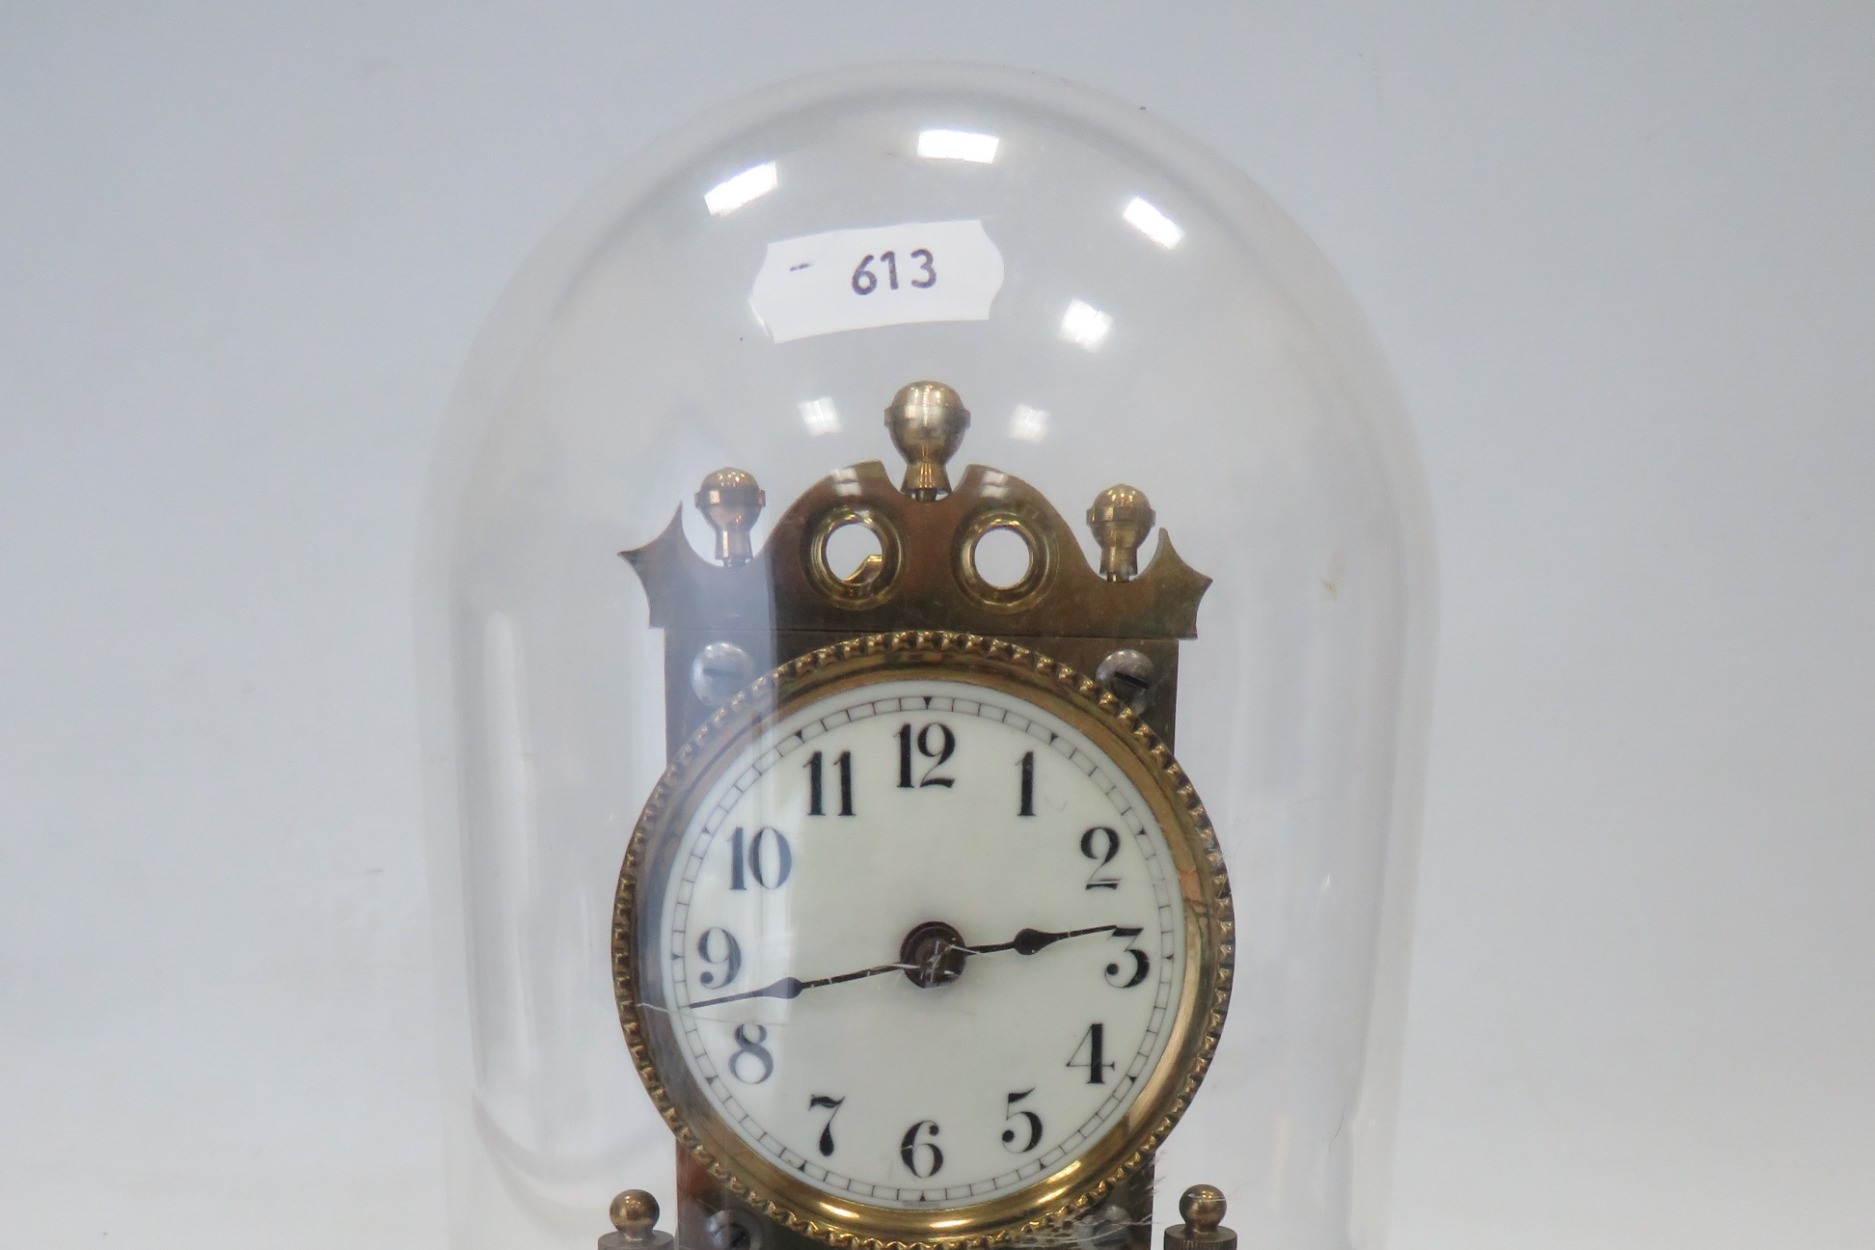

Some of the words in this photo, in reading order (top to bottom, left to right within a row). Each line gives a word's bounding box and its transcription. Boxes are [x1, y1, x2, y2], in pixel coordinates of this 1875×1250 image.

[851, 248, 937, 296] 613
[803, 750, 857, 817] 11
[894, 721, 957, 789] 12
[1016, 750, 1037, 817] 1
[727, 826, 792, 891] 10
[1080, 826, 1121, 890] 2
[698, 927, 741, 989] 9
[1105, 925, 1150, 989] 3
[728, 1024, 774, 1084] 8
[1066, 1023, 1115, 1085] 4
[808, 1094, 845, 1157] 7
[901, 1120, 944, 1178] 6
[1002, 1088, 1043, 1154] 5
